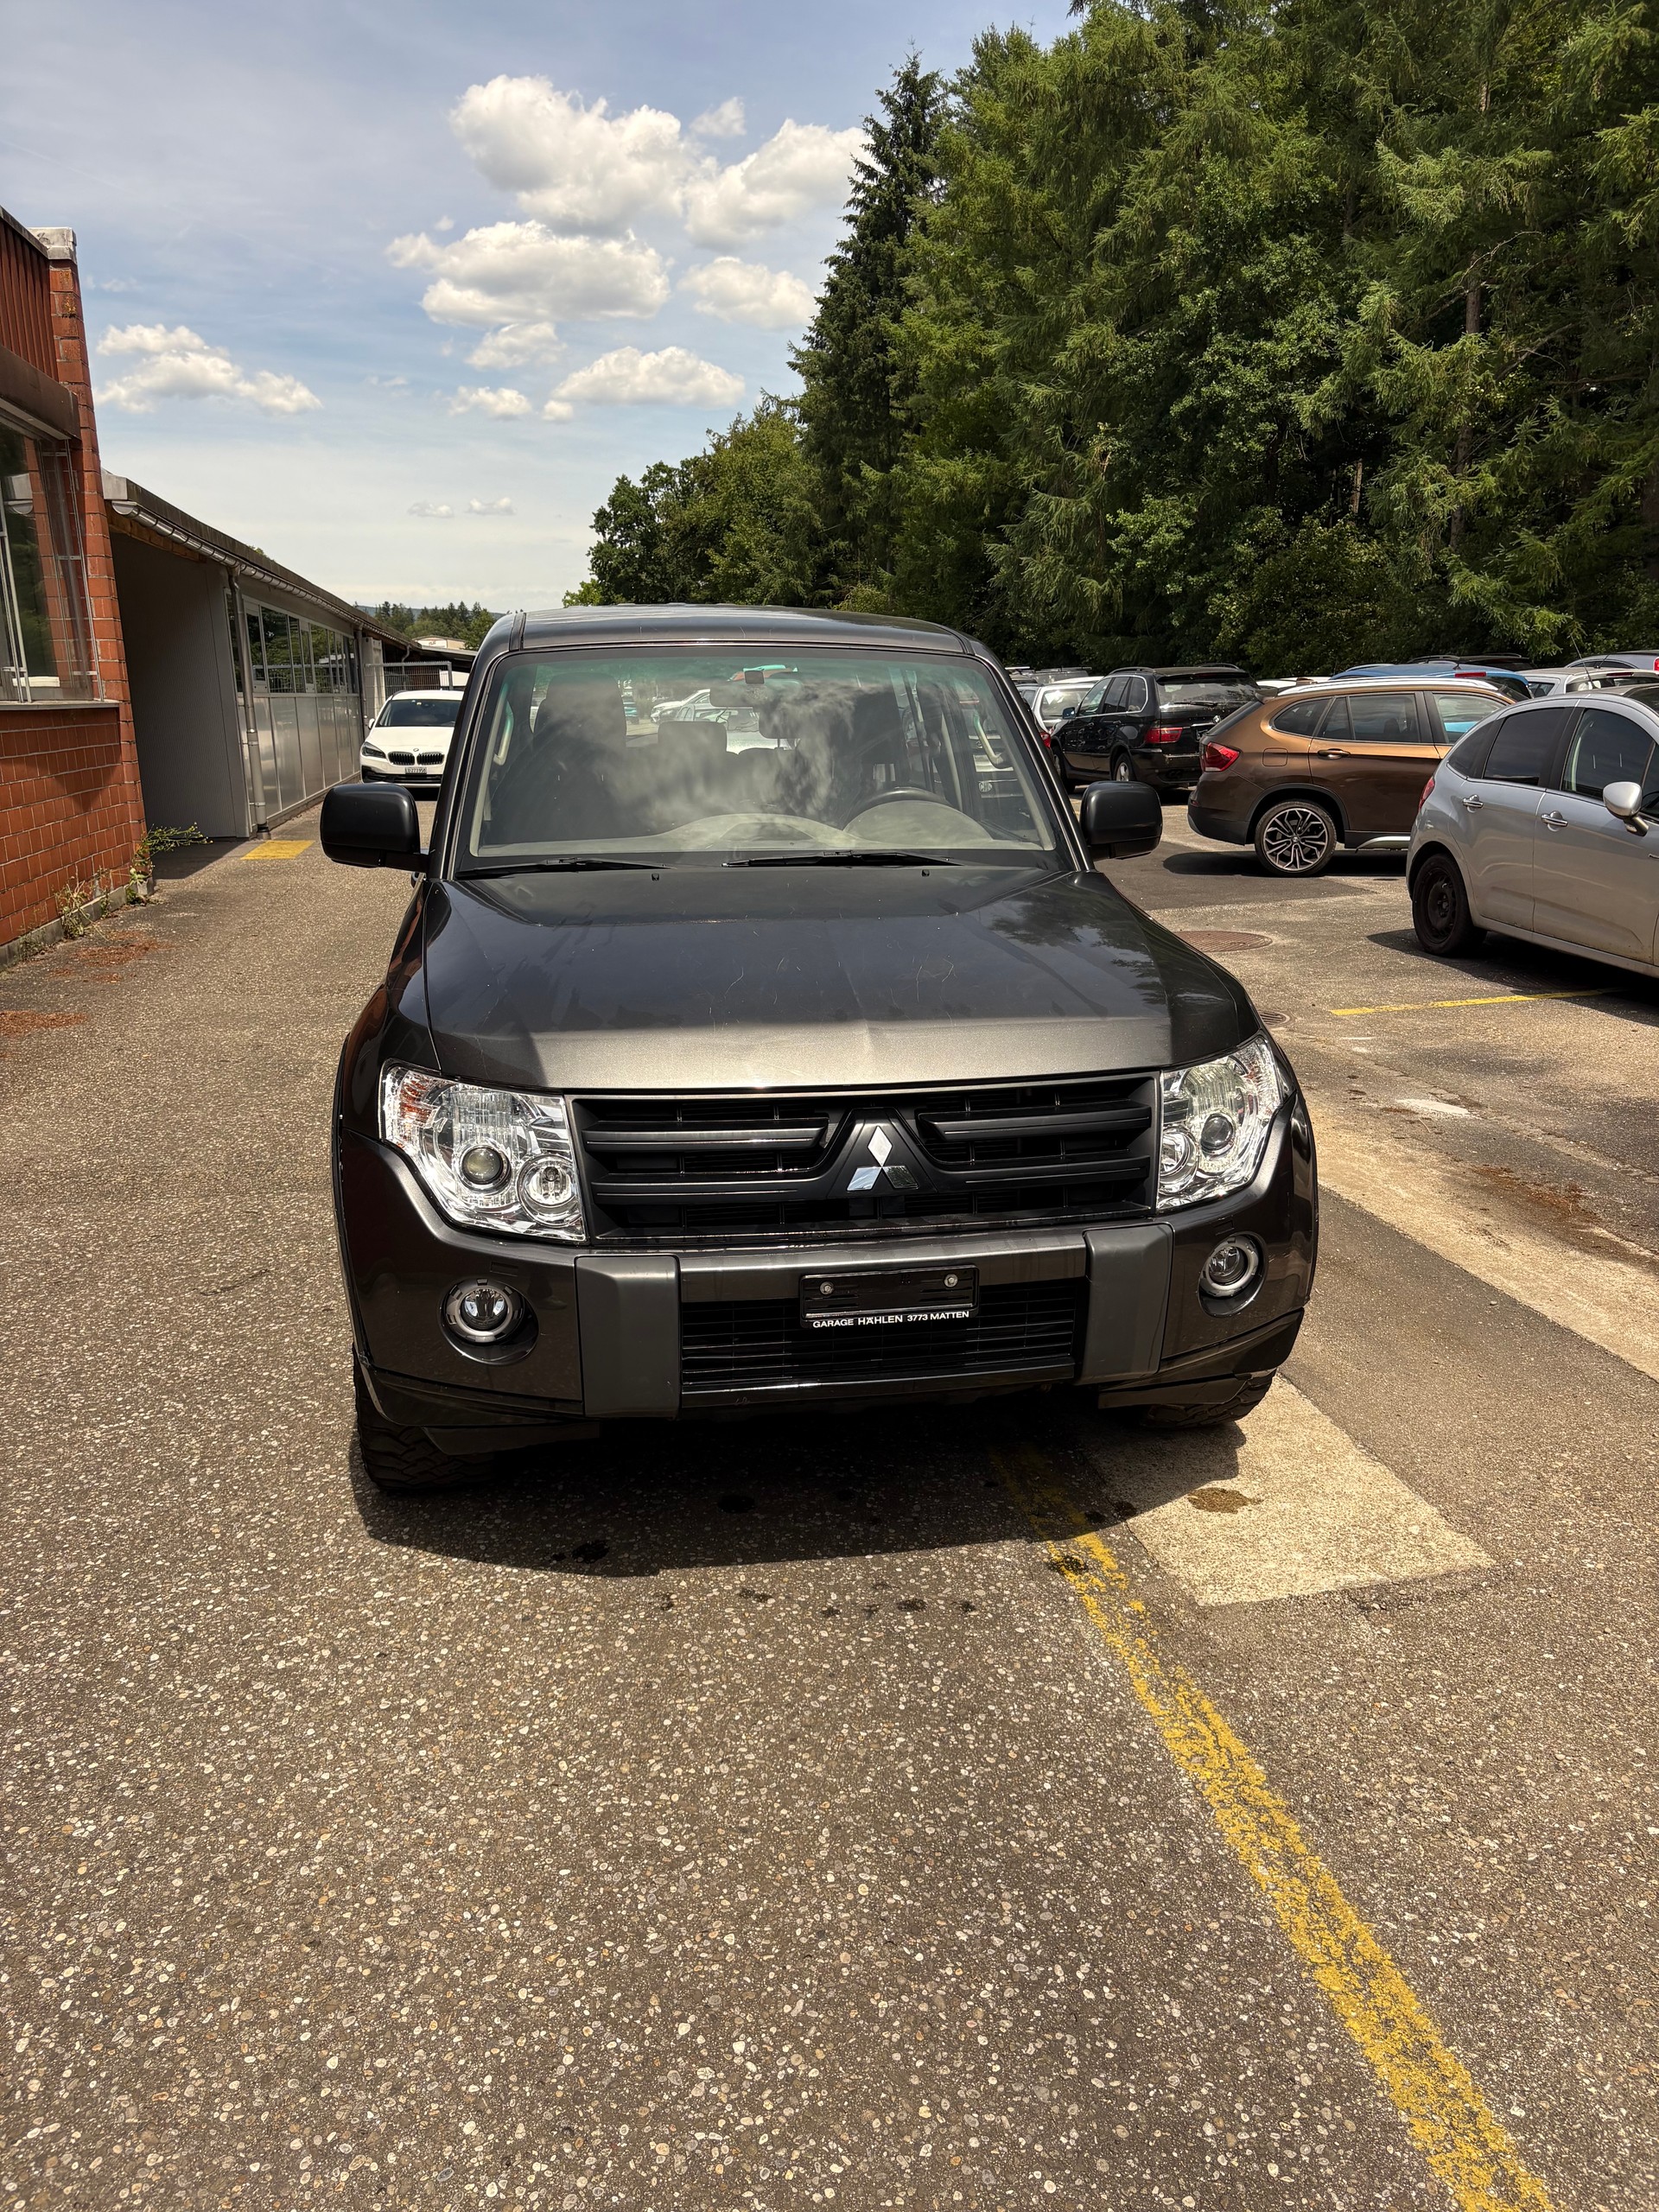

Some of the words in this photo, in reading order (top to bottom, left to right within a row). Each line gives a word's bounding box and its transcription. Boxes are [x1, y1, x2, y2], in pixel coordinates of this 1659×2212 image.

[812, 1319, 854, 1328] GARAGE
[857, 1314, 903, 1325] HÄHLEN
[906, 1313, 928, 1322] 3773
[930, 1311, 969, 1320] MATTEN
